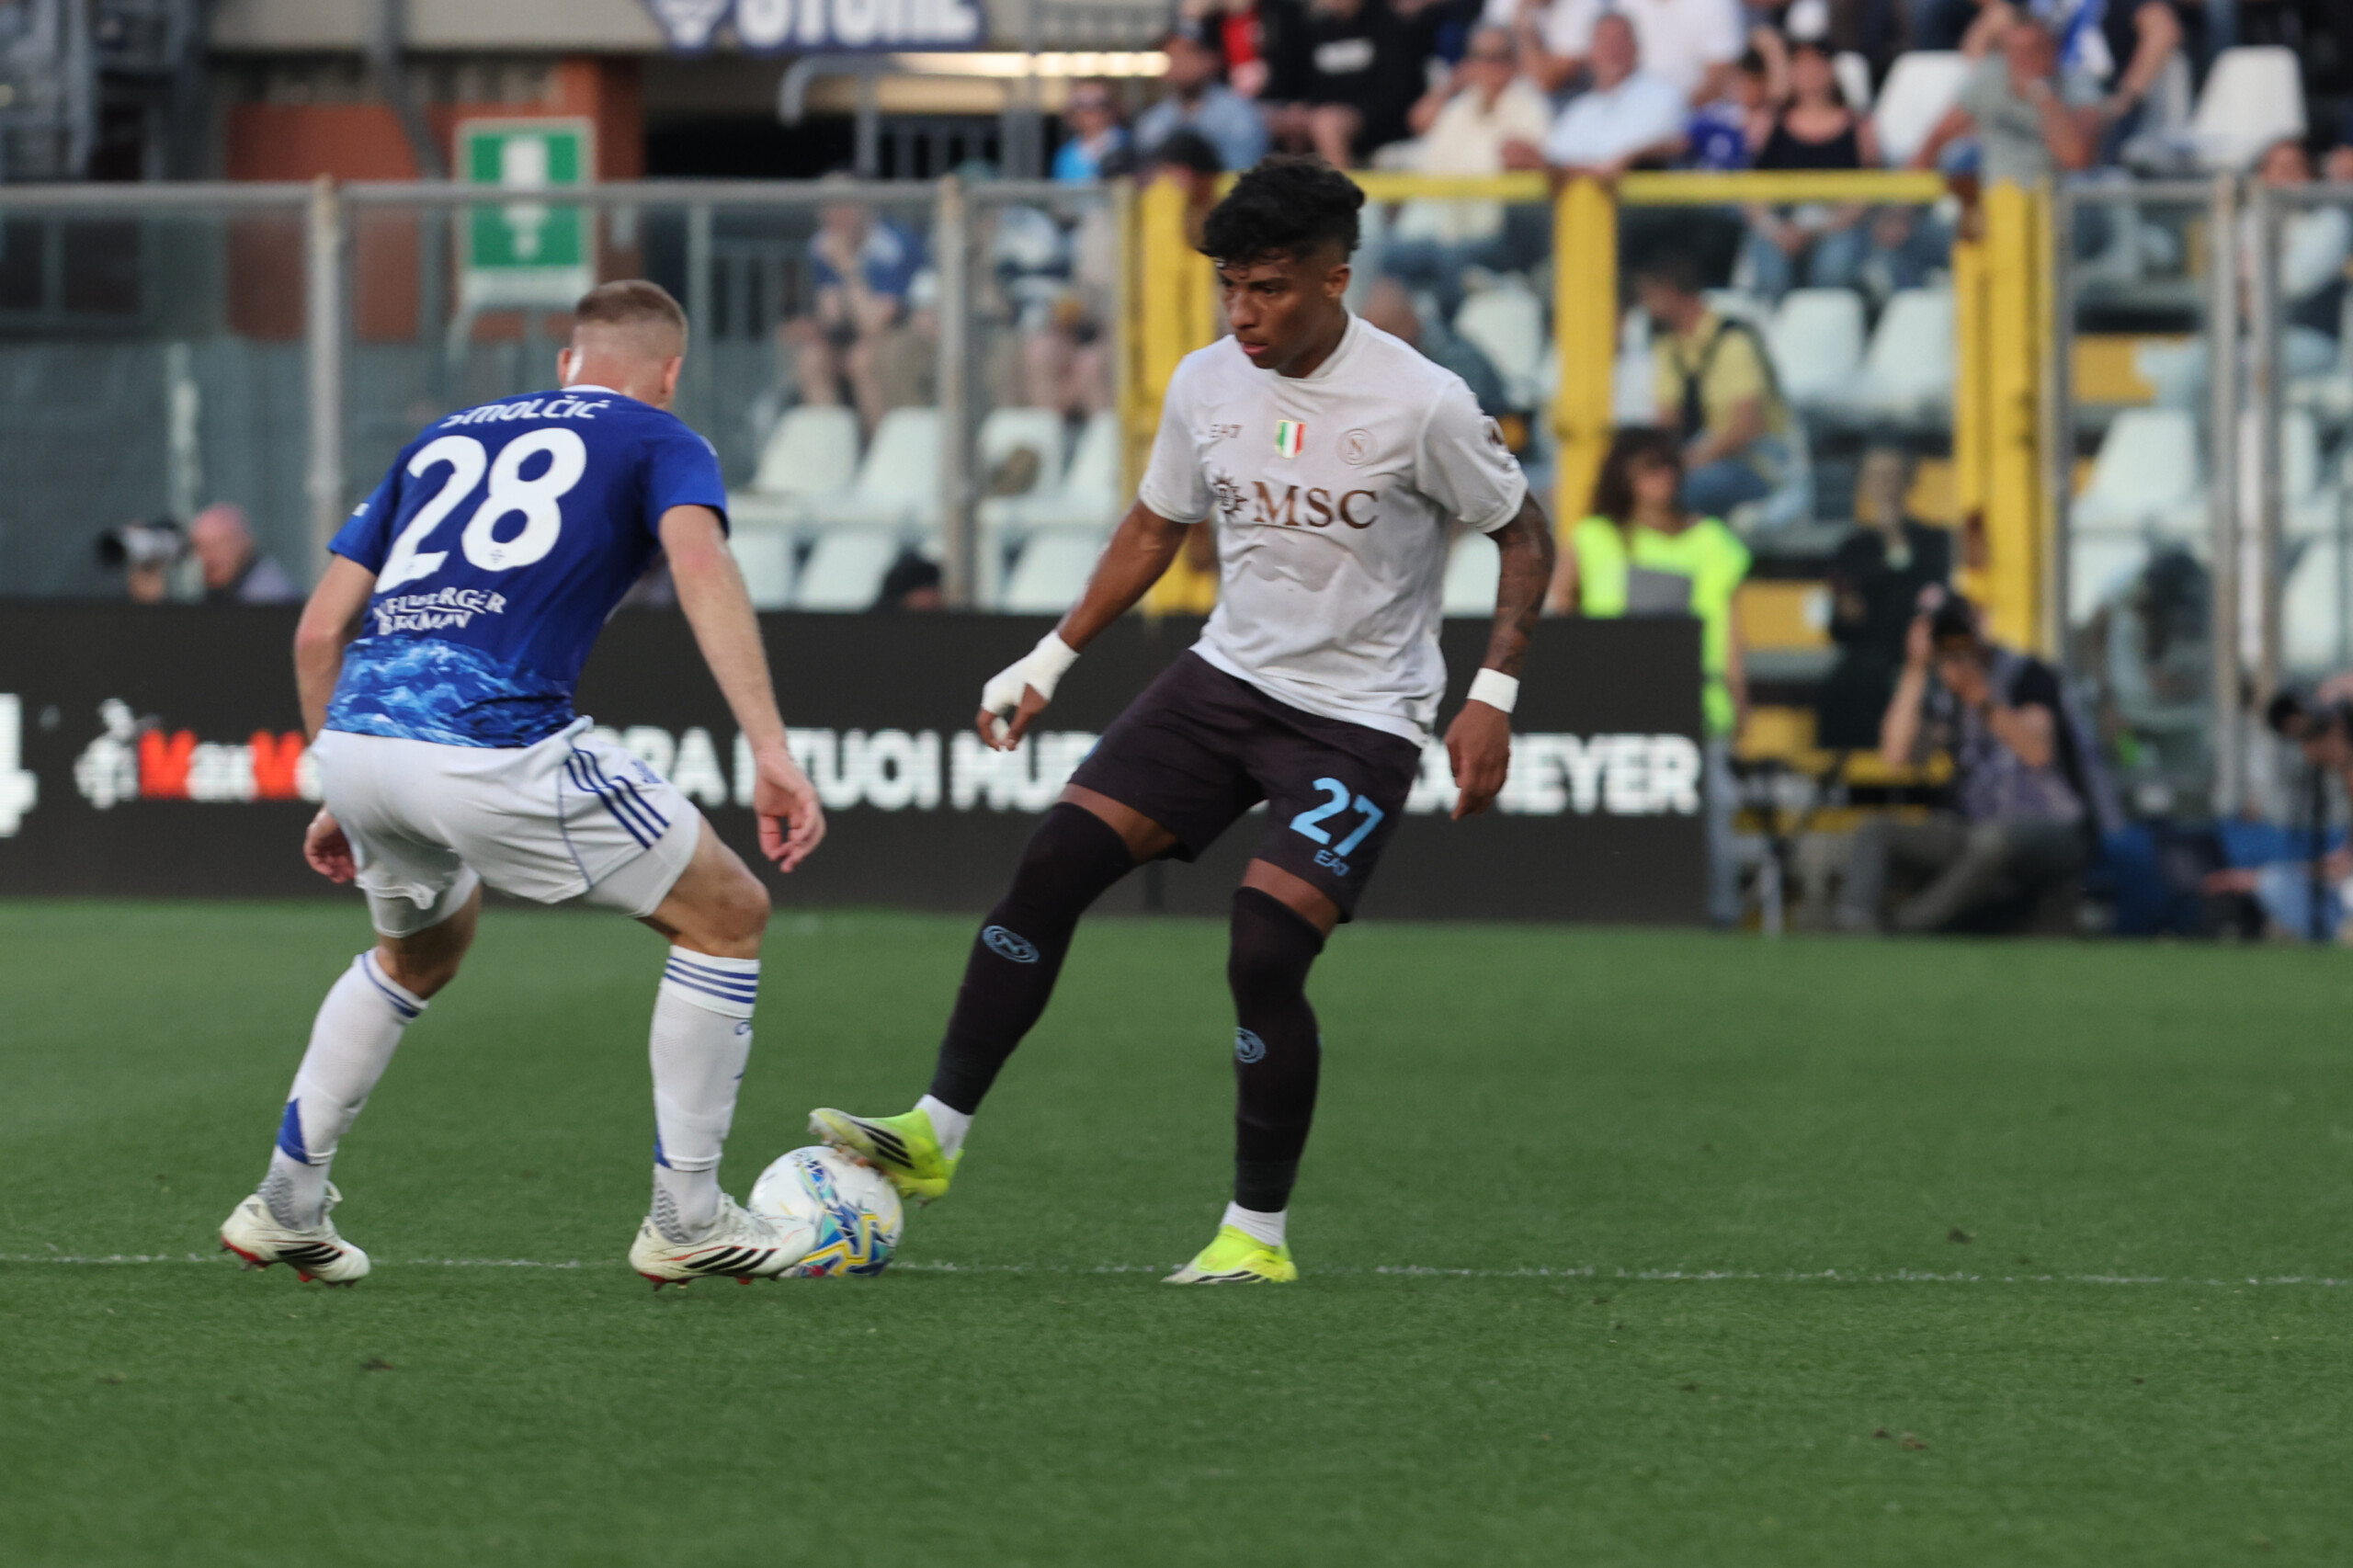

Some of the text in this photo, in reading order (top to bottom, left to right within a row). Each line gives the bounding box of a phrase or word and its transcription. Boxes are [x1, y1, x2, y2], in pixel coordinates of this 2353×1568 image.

[374, 426, 587, 595] 28
[1251, 480, 1380, 530] MSC
[1289, 777, 1386, 858] 27
